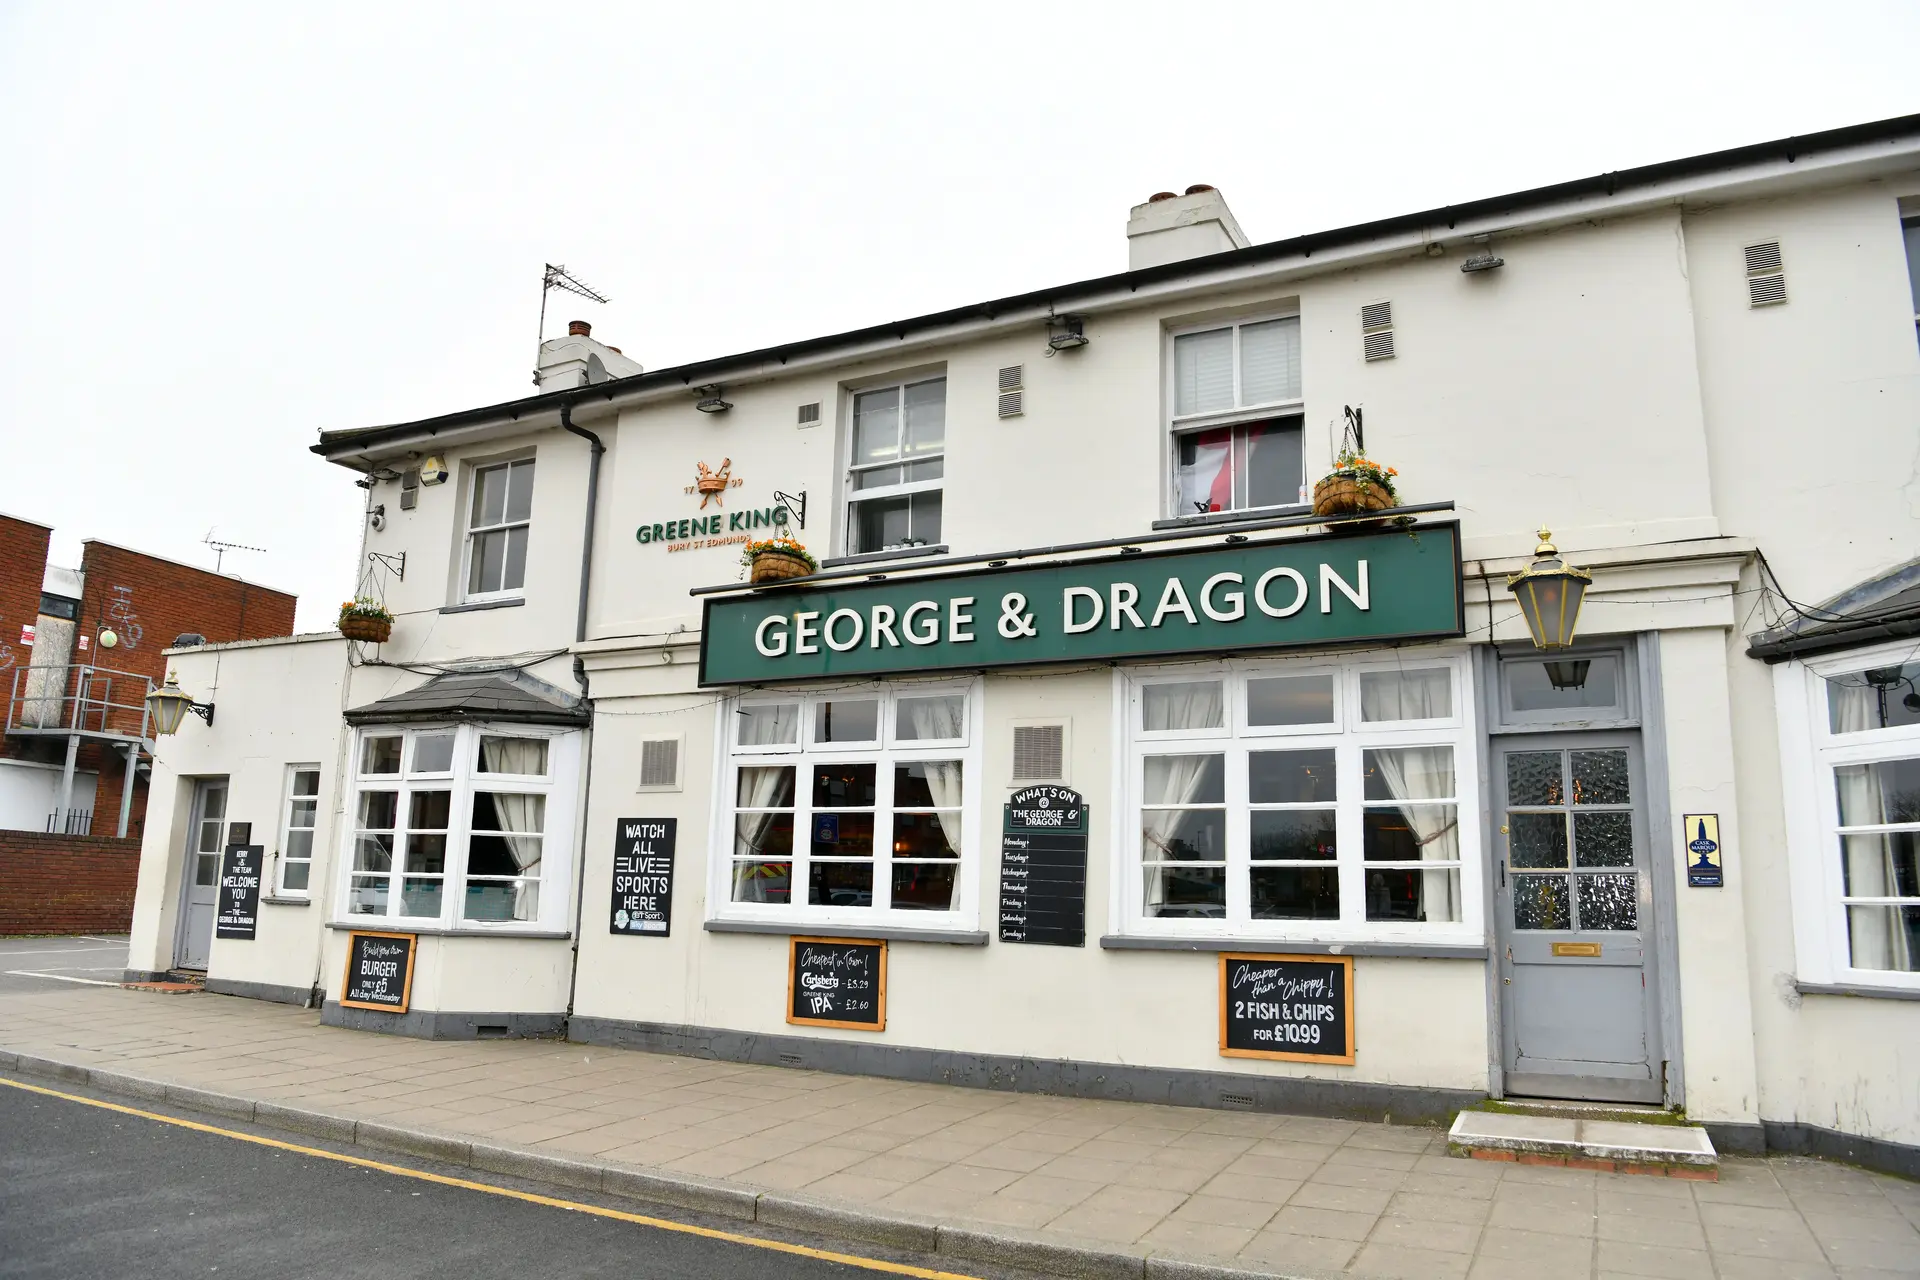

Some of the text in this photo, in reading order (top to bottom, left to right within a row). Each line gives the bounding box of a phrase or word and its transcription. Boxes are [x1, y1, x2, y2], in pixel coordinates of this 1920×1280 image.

[731, 478, 744, 488] 99
[636, 505, 788, 544] GREENE KING
[667, 541, 690, 552] BURY
[694, 540, 704, 549] ST
[755, 558, 1372, 658] GEORGE & DRAGON
[1015, 786, 1076, 804] WHAT'S ON
[1012, 810, 1078, 820] THE GEORGE &
[1026, 818, 1062, 826] DRAGON
[626, 824, 666, 838] WATCH
[632, 841, 655, 854] ALL
[1003, 838, 1026, 848] Monday
[1004, 852, 1027, 863] Tuesday
[628, 857, 656, 873] LIVE
[222, 876, 258, 888] WELCOME
[616, 876, 668, 894] SPORTS
[1002, 882, 1025, 893] Thursday
[232, 888, 246, 899] YOU
[623, 896, 656, 910] HERE
[1002, 898, 1022, 908] Friday
[219, 915, 233, 923] GEORGE
[238, 916, 254, 924] DRAGON
[645, 912, 661, 920] Sport
[1001, 913, 1024, 925] Saturday
[1002, 929, 1022, 940] Sunday
[801, 948, 838, 971] Cheapest
[361, 960, 397, 977] BURGER
[801, 972, 869, 989] Carlsberg £3.29
[1232, 964, 1282, 989] Cheaper
[362, 978, 388, 993] ONLY £5
[1251, 981, 1276, 999] than
[1278, 978, 1286, 986] a
[350, 989, 400, 1003] All day Wednesday
[810, 996, 869, 1014] IPA £2.60
[1235, 1000, 1335, 1021] 2 FISH & CHIPS
[1254, 1029, 1273, 1040] FOR
